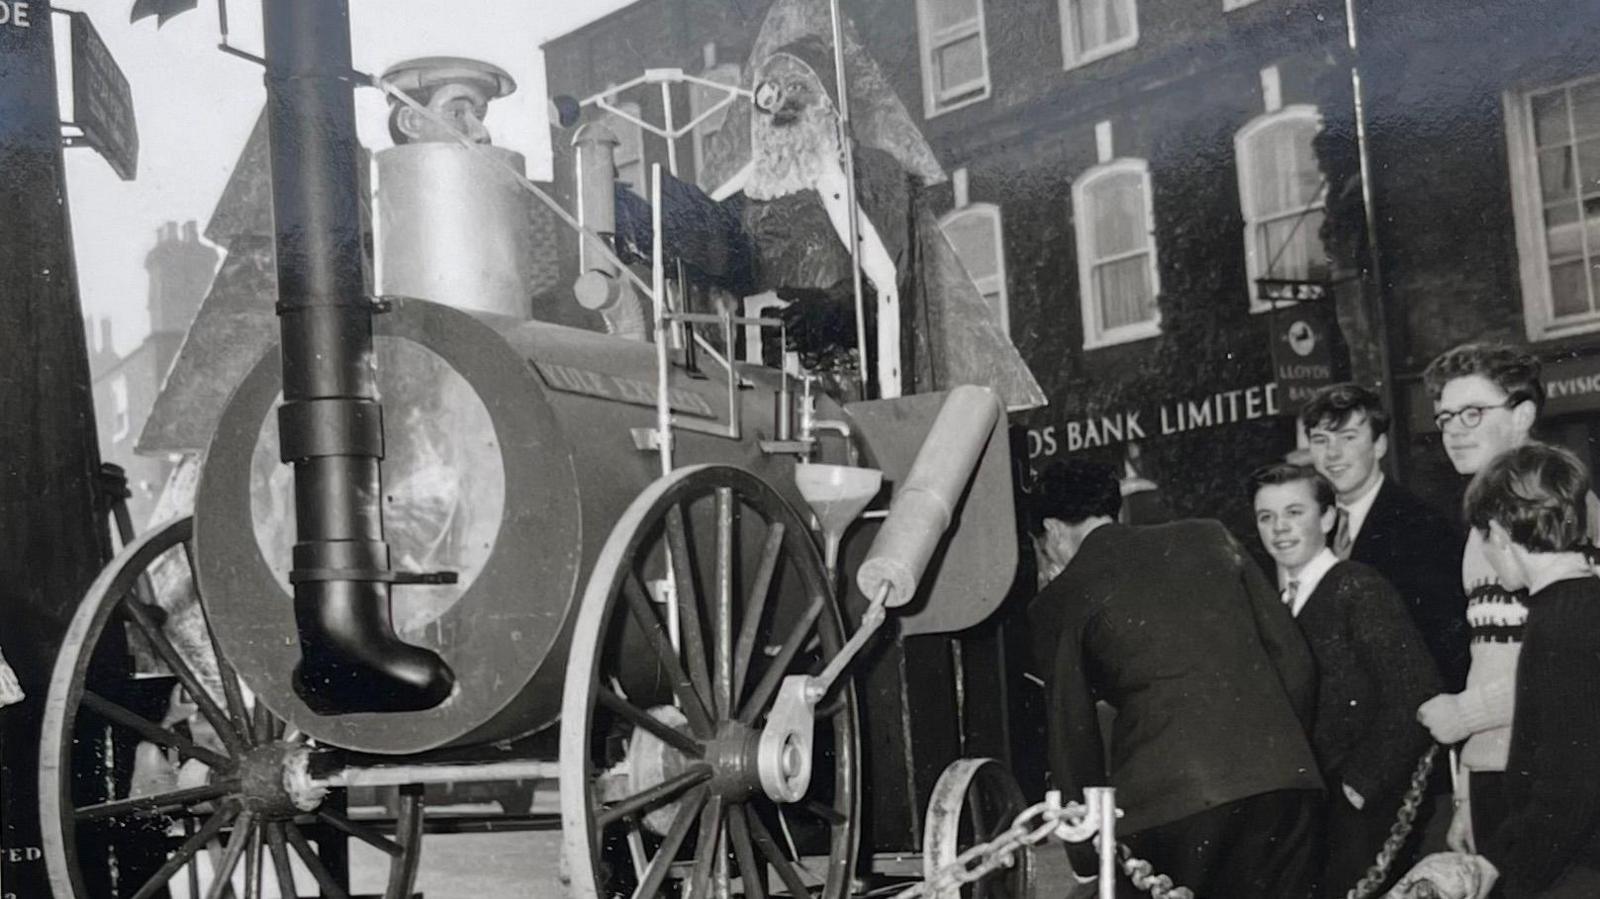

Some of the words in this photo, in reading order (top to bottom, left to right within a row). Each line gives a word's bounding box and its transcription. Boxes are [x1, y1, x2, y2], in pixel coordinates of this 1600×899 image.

[1279, 365, 1329, 379] LLOYDS
[1066, 410, 1146, 452] BANK
[1161, 382, 1280, 436] LIMITED
[1, 847, 42, 862] ED
